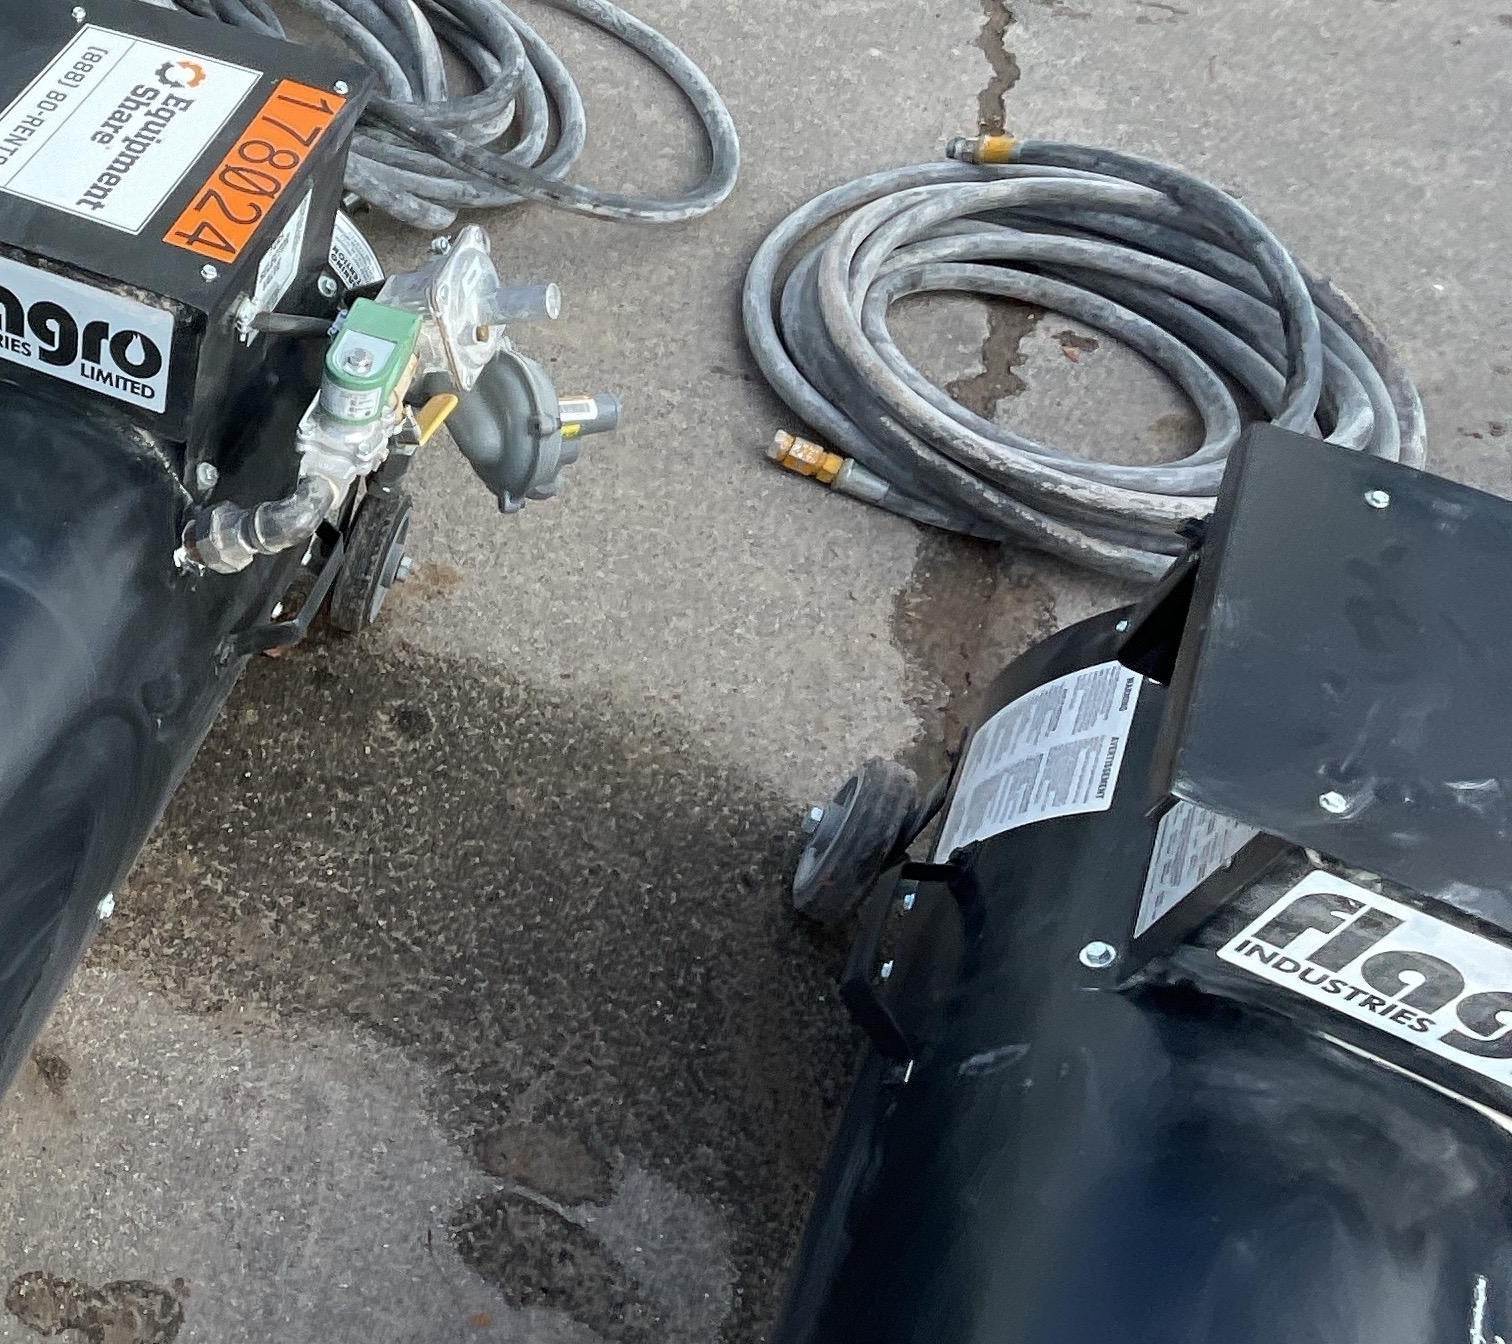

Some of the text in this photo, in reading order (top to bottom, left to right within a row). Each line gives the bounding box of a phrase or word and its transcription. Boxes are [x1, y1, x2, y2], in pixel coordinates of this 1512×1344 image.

[64, 45, 109, 88] (888)
[76, 94, 195, 212] Equipment
[90, 83, 160, 145] Share
[174, 93, 335, 255] 178024
[80, 362, 156, 400] LIMITED
[1234, 939, 1437, 1034] INDUSTRIES
